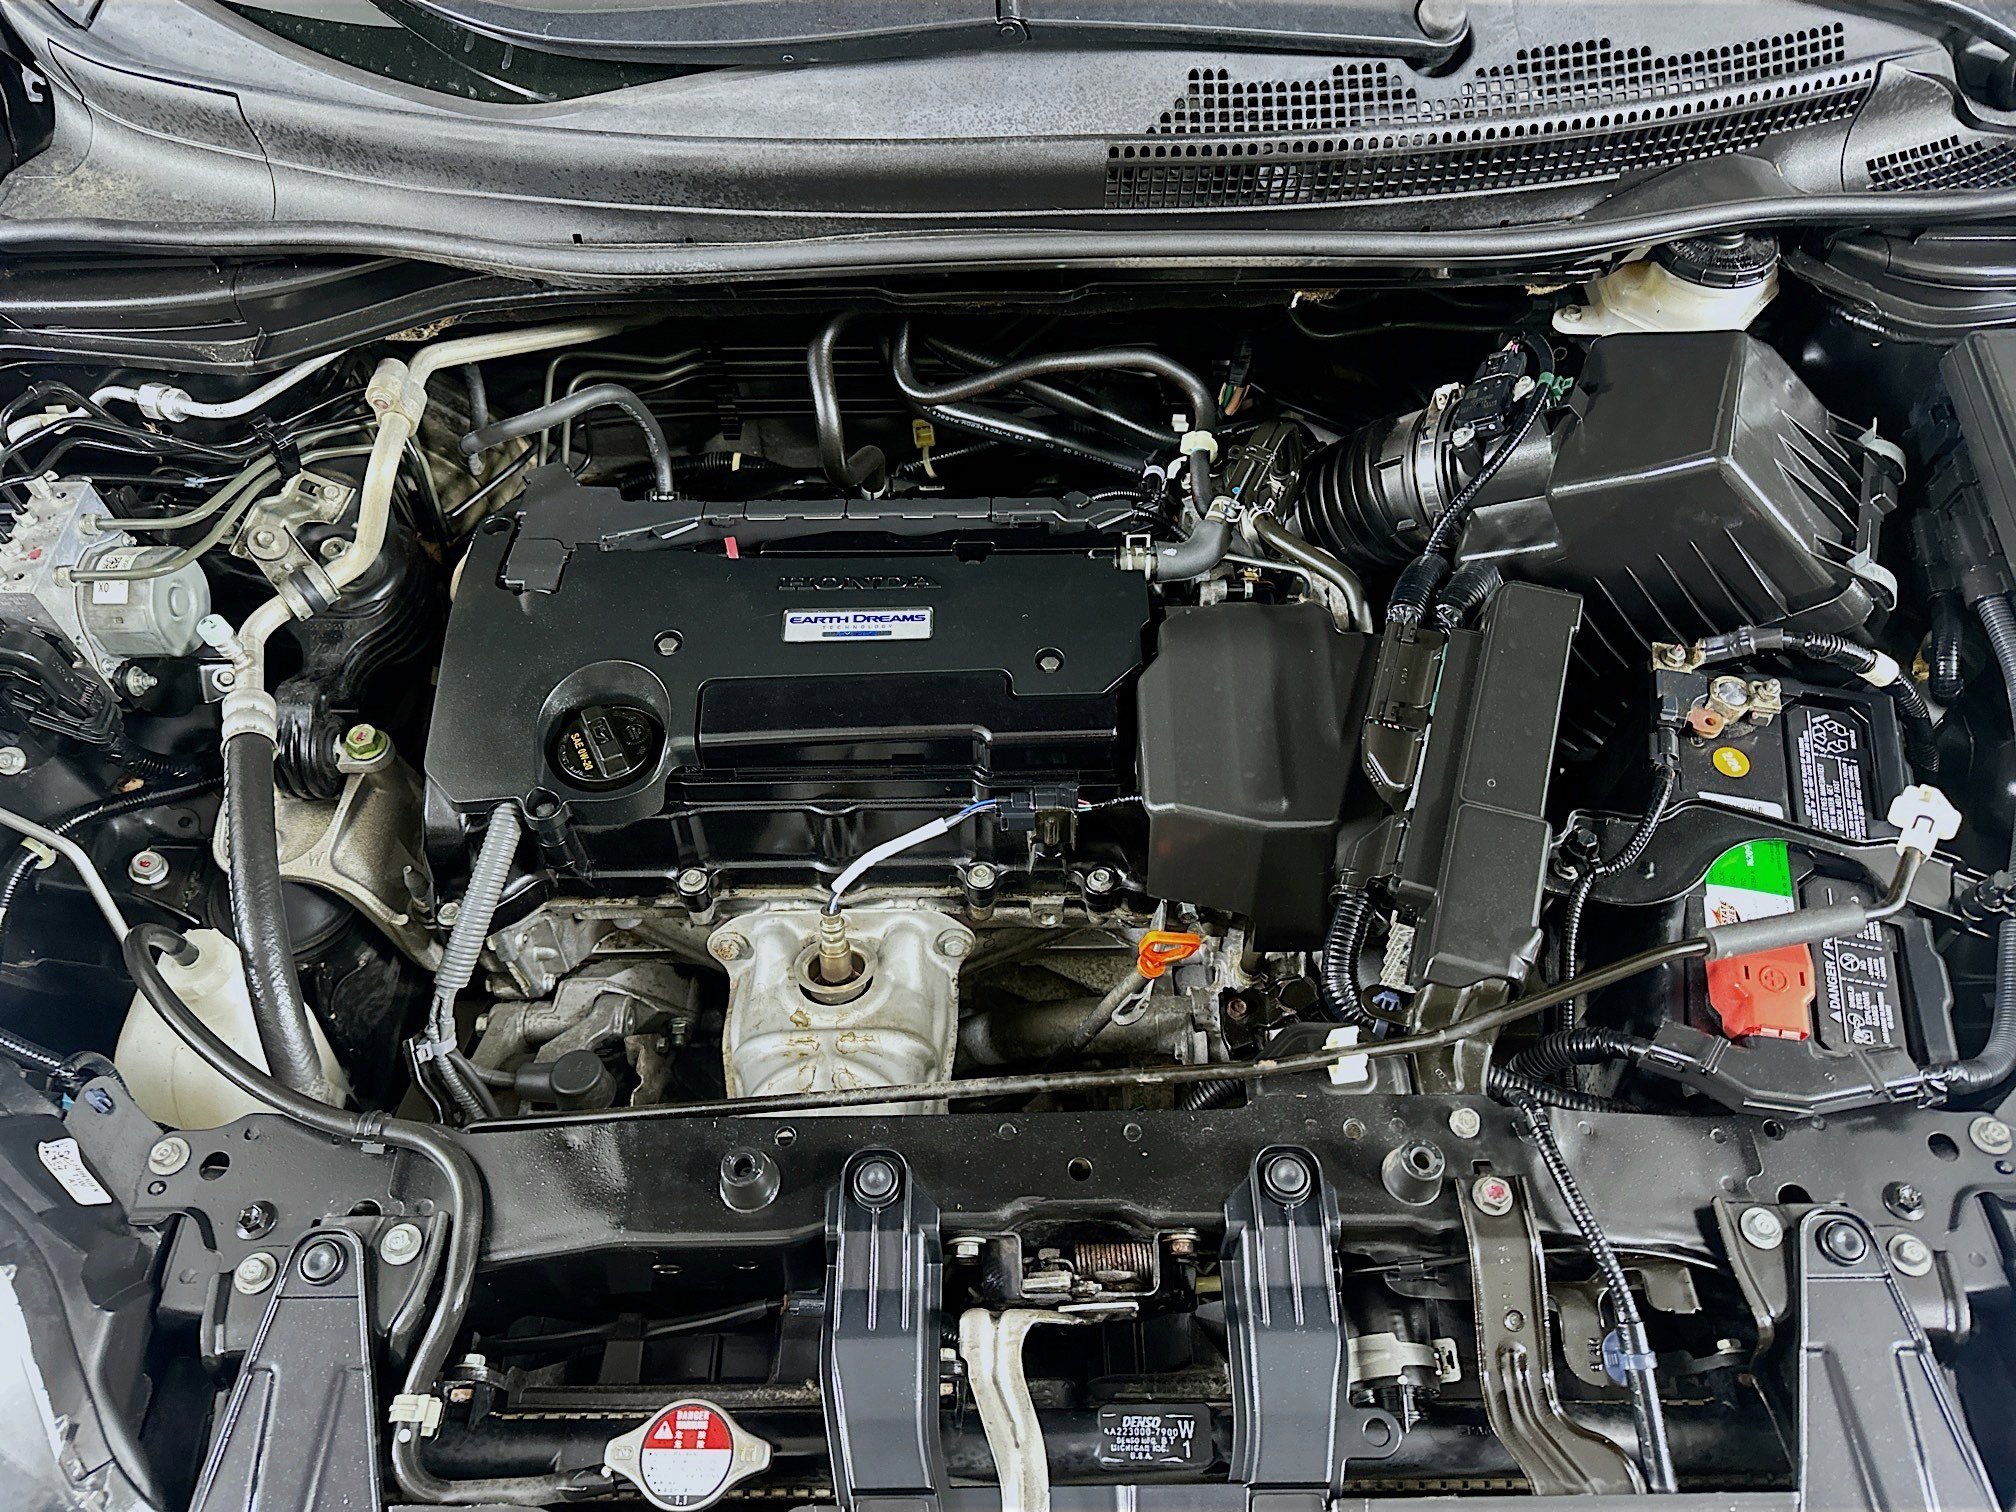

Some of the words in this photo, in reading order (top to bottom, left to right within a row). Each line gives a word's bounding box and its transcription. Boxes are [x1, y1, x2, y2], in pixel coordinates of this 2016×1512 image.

[778, 576, 942, 591] HONDA
[789, 616, 849, 624] EARTH
[853, 615, 926, 623] DREAMS
[571, 732, 584, 749] SAE
[1847, 985, 1856, 1009] SHIELD
[1855, 993, 1864, 1009] EYES
[1862, 991, 1872, 1026] EXPLOSIVE
[1122, 1416, 1161, 1428] DENSO
[1177, 1420, 1195, 1439] W
[1111, 1444, 1150, 1452] MICHIGAN
[1183, 1440, 1191, 1458] 1
